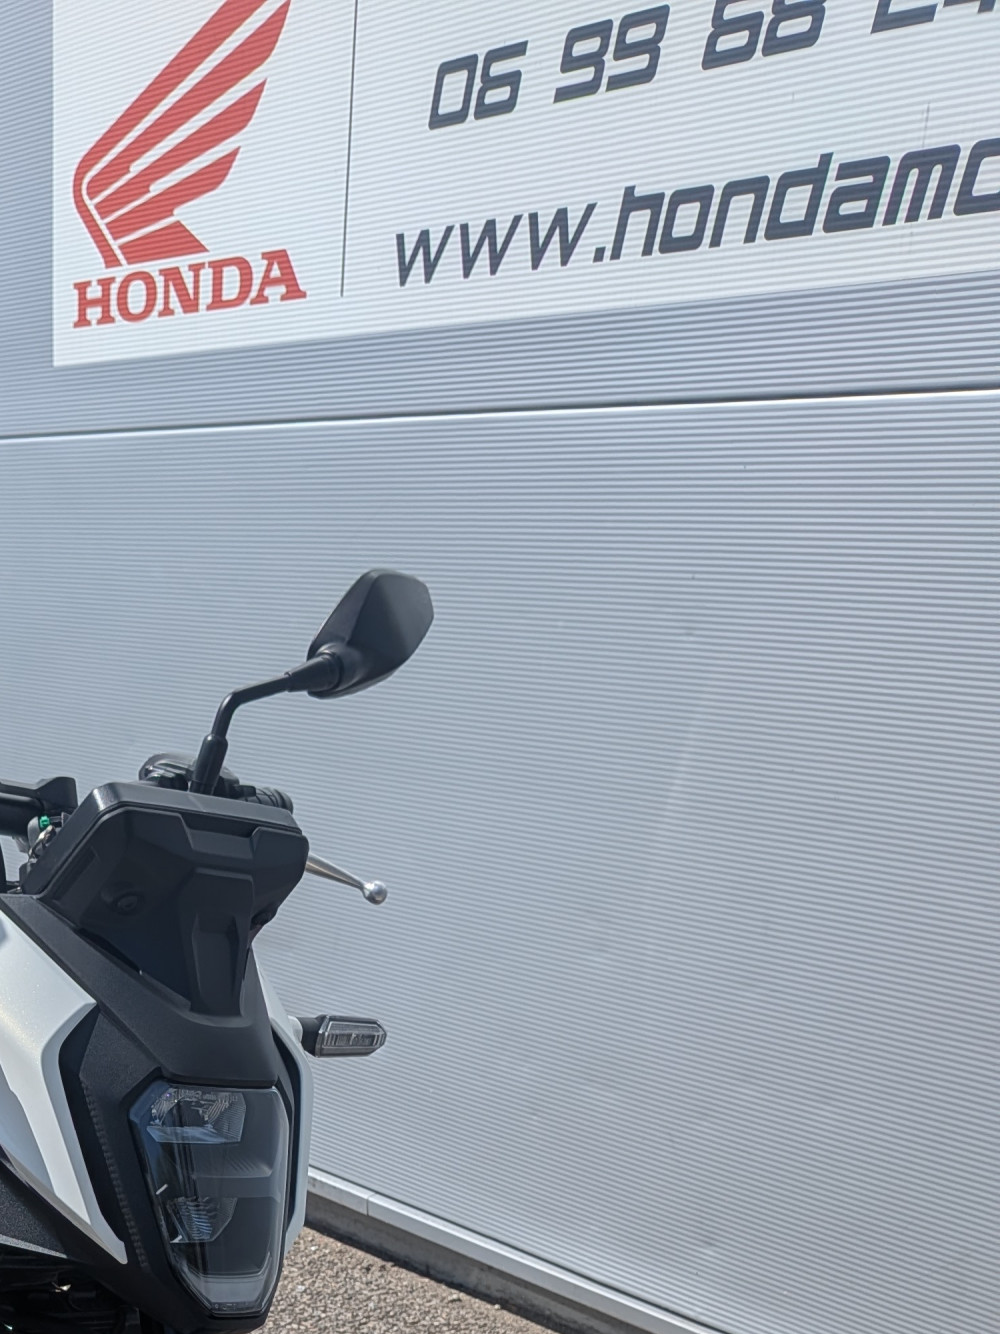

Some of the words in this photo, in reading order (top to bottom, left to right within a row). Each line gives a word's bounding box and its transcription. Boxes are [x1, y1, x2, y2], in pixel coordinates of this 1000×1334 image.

[428, 40, 528, 130] 06
[553, 4, 670, 104] 99
[701, 0, 826, 70] 68
[73, 249, 307, 328] HONDA
